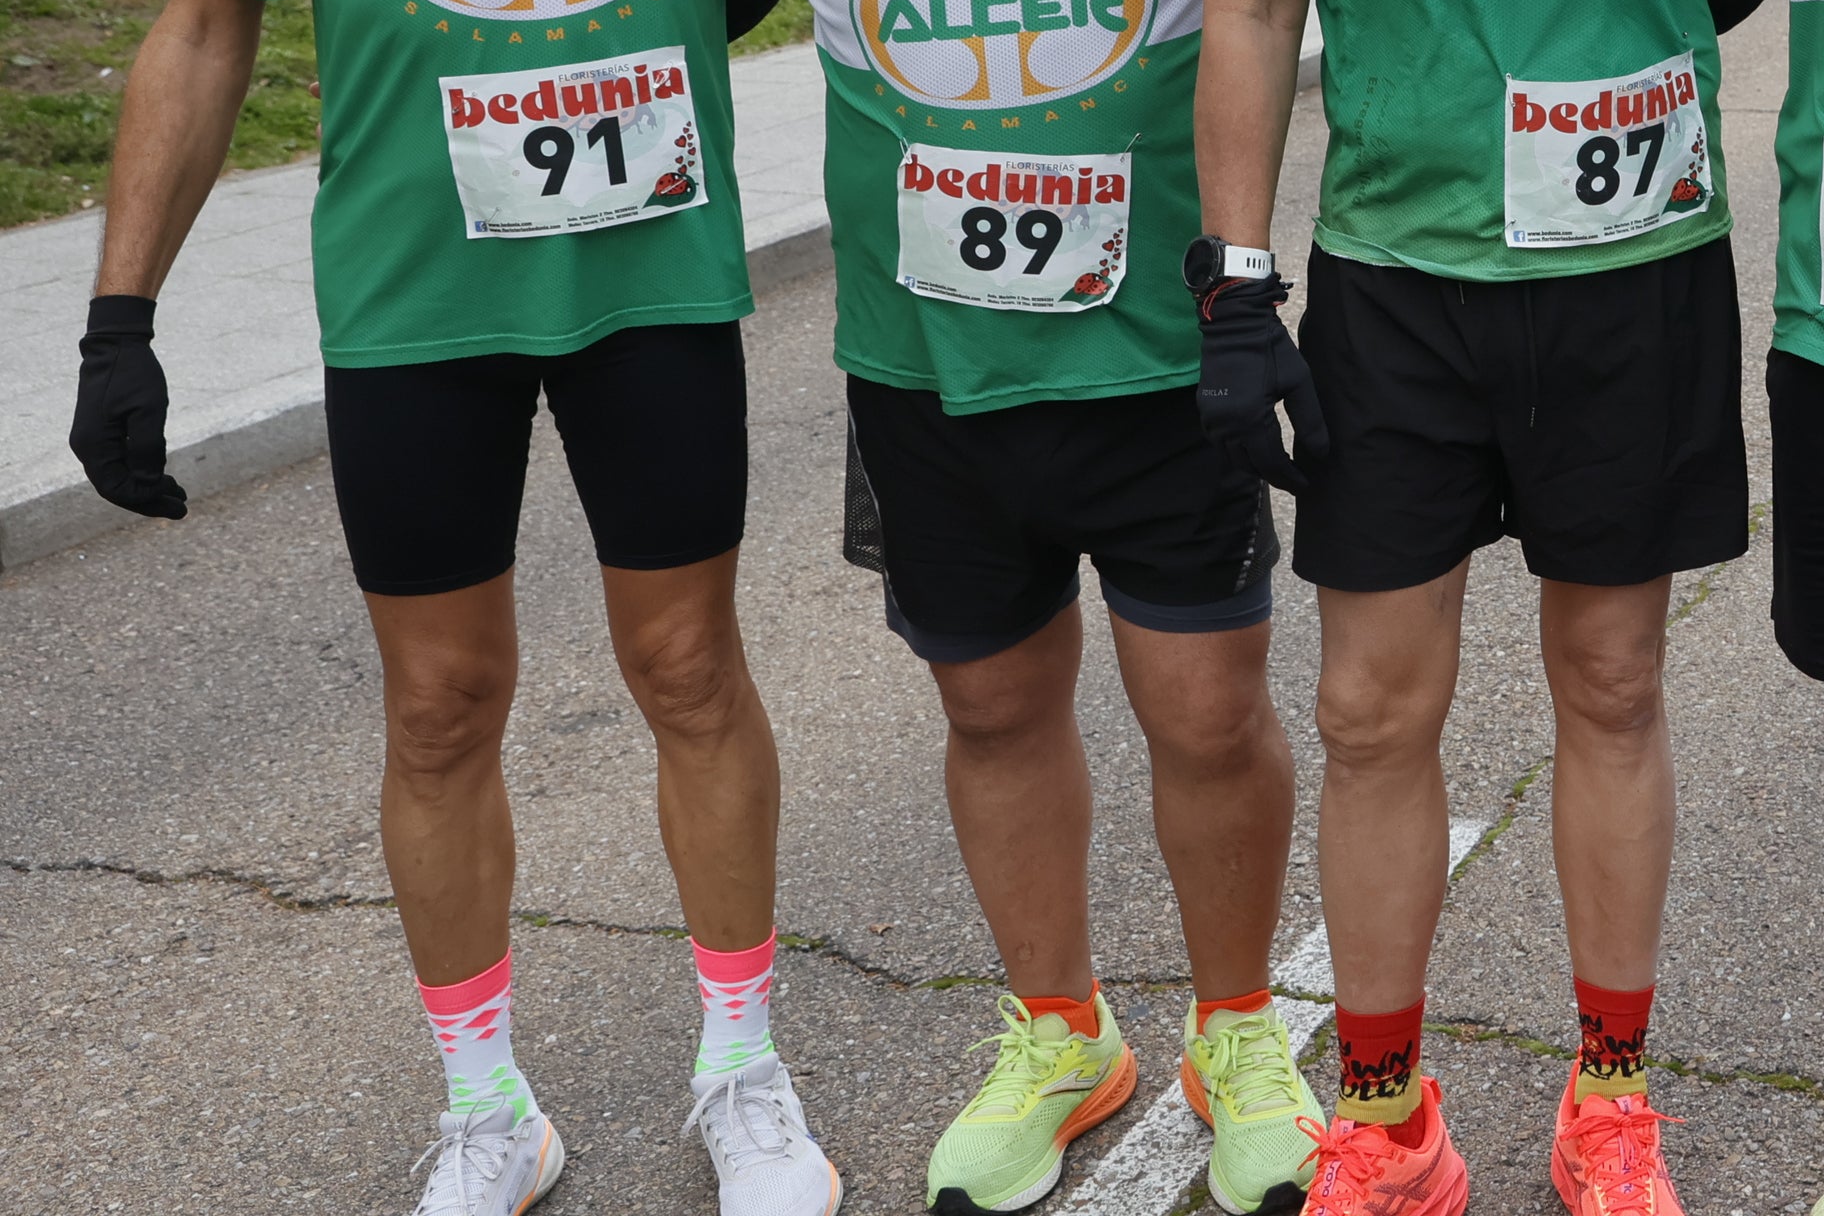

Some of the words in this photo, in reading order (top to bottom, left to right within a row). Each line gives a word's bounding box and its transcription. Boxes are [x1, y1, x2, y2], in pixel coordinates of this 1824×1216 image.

[448, 64, 685, 129] bedunia
[558, 63, 630, 83] FLORISTERÍAS
[874, 56, 1149, 130] SALAMANCA
[1512, 70, 1695, 134] bedunia
[523, 116, 628, 197] 91
[904, 154, 1125, 205] bedunia
[1005, 160, 1075, 172] FLORISTERÍAS
[1575, 122, 1665, 206] 87
[960, 206, 1063, 275] 89
